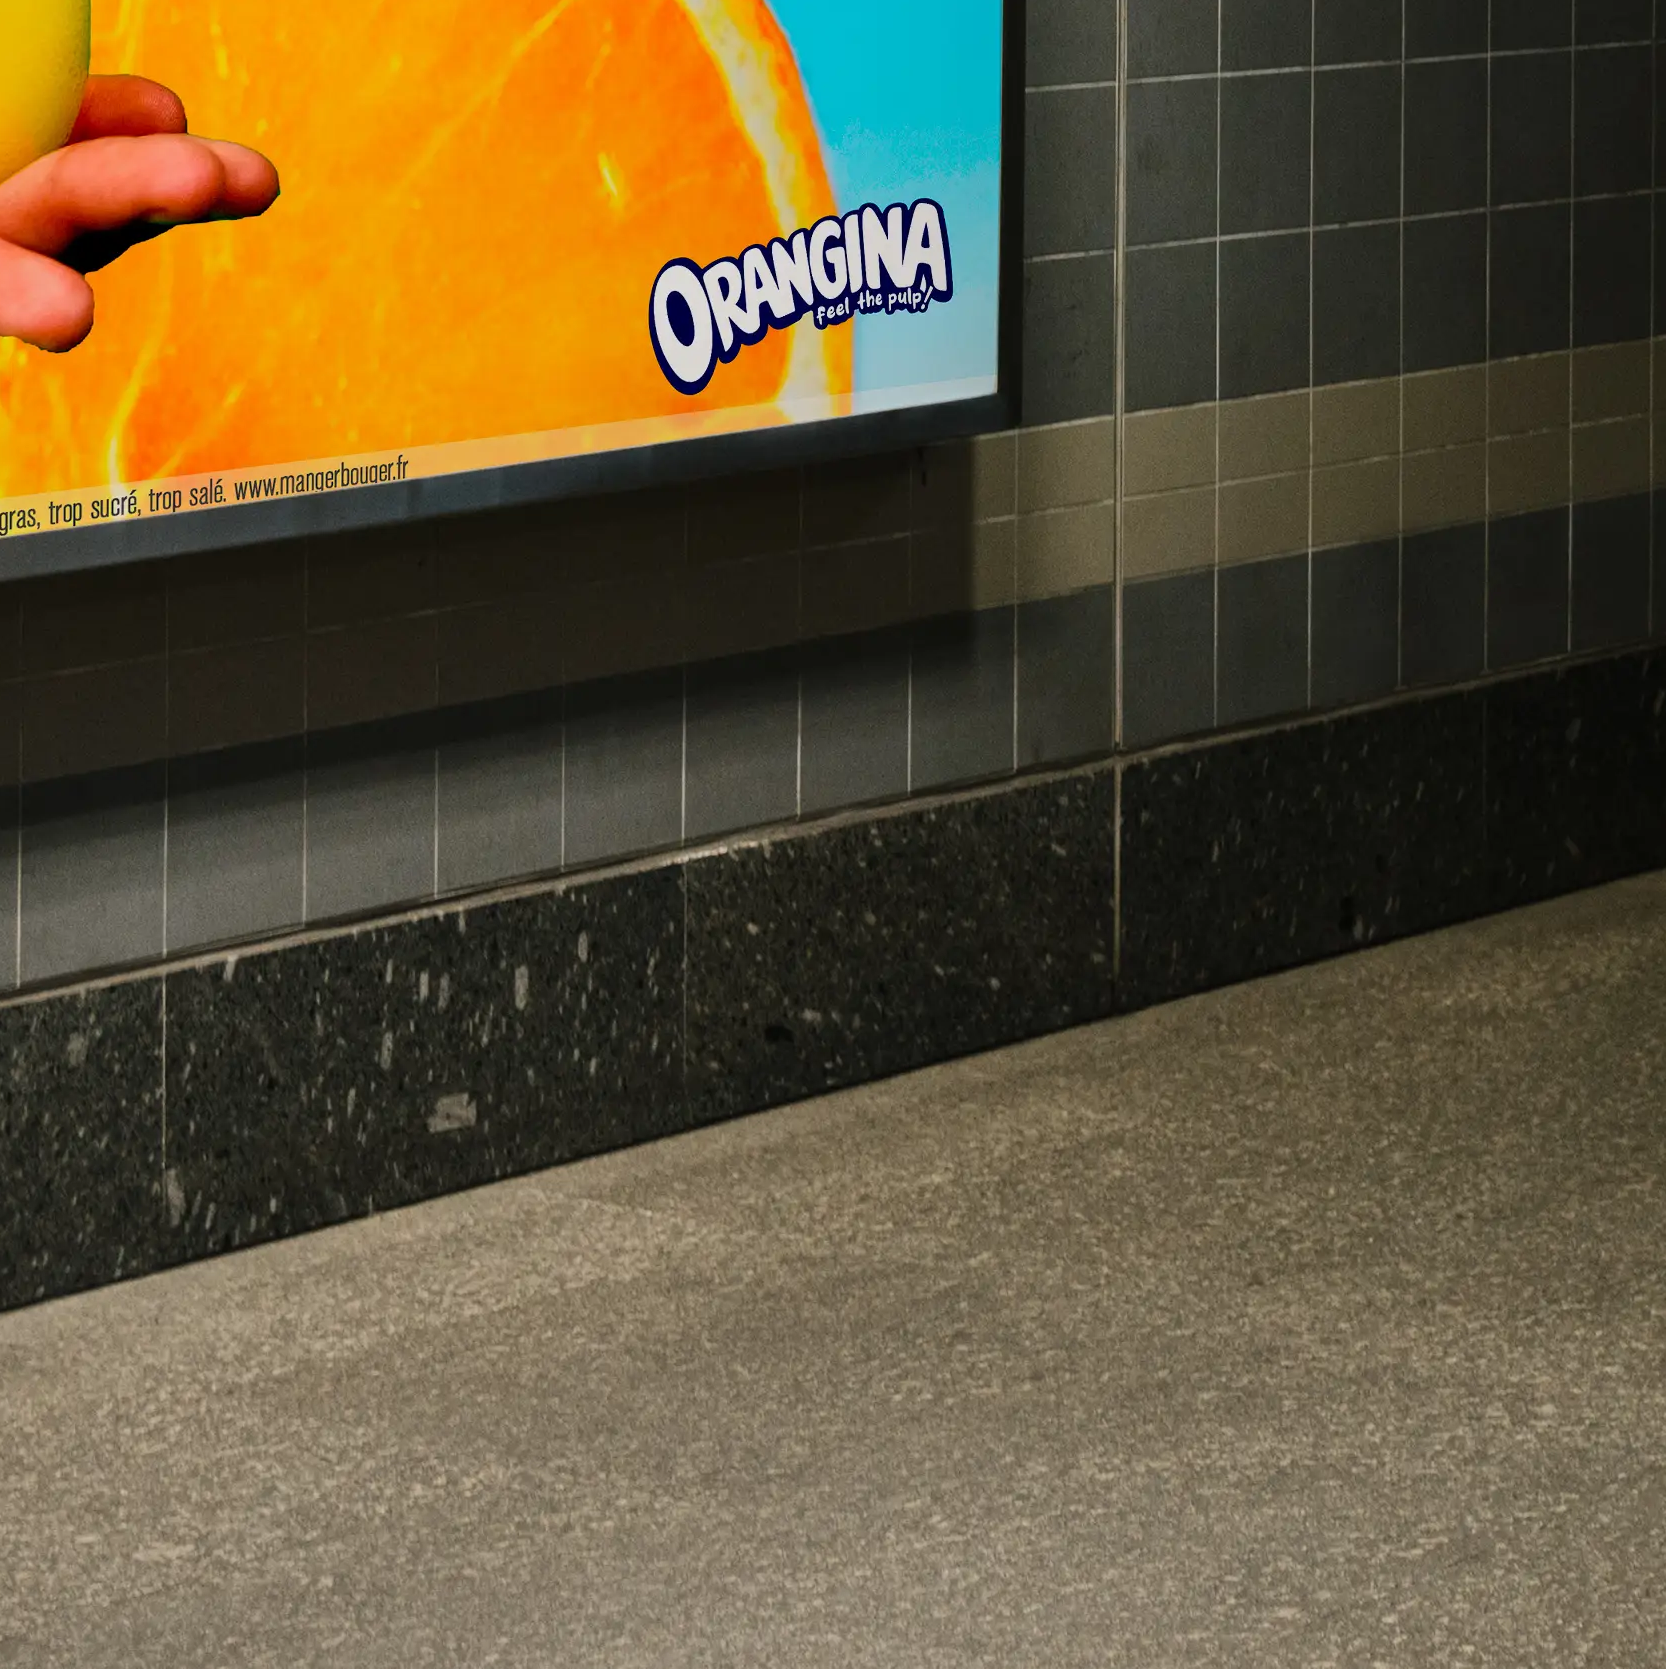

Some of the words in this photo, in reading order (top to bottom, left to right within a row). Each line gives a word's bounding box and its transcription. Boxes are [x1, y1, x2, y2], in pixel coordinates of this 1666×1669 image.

[652, 201, 947, 384] ORANGINA
[816, 296, 850, 326] feel
[857, 289, 883, 310] the
[887, 285, 934, 312] pulp!
[48, 501, 83, 527] trop
[90, 489, 142, 519] sucré,
[148, 488, 182, 513] trop
[189, 478, 227, 507] salé.
[234, 454, 409, 501] www.mangerbouger.fr
